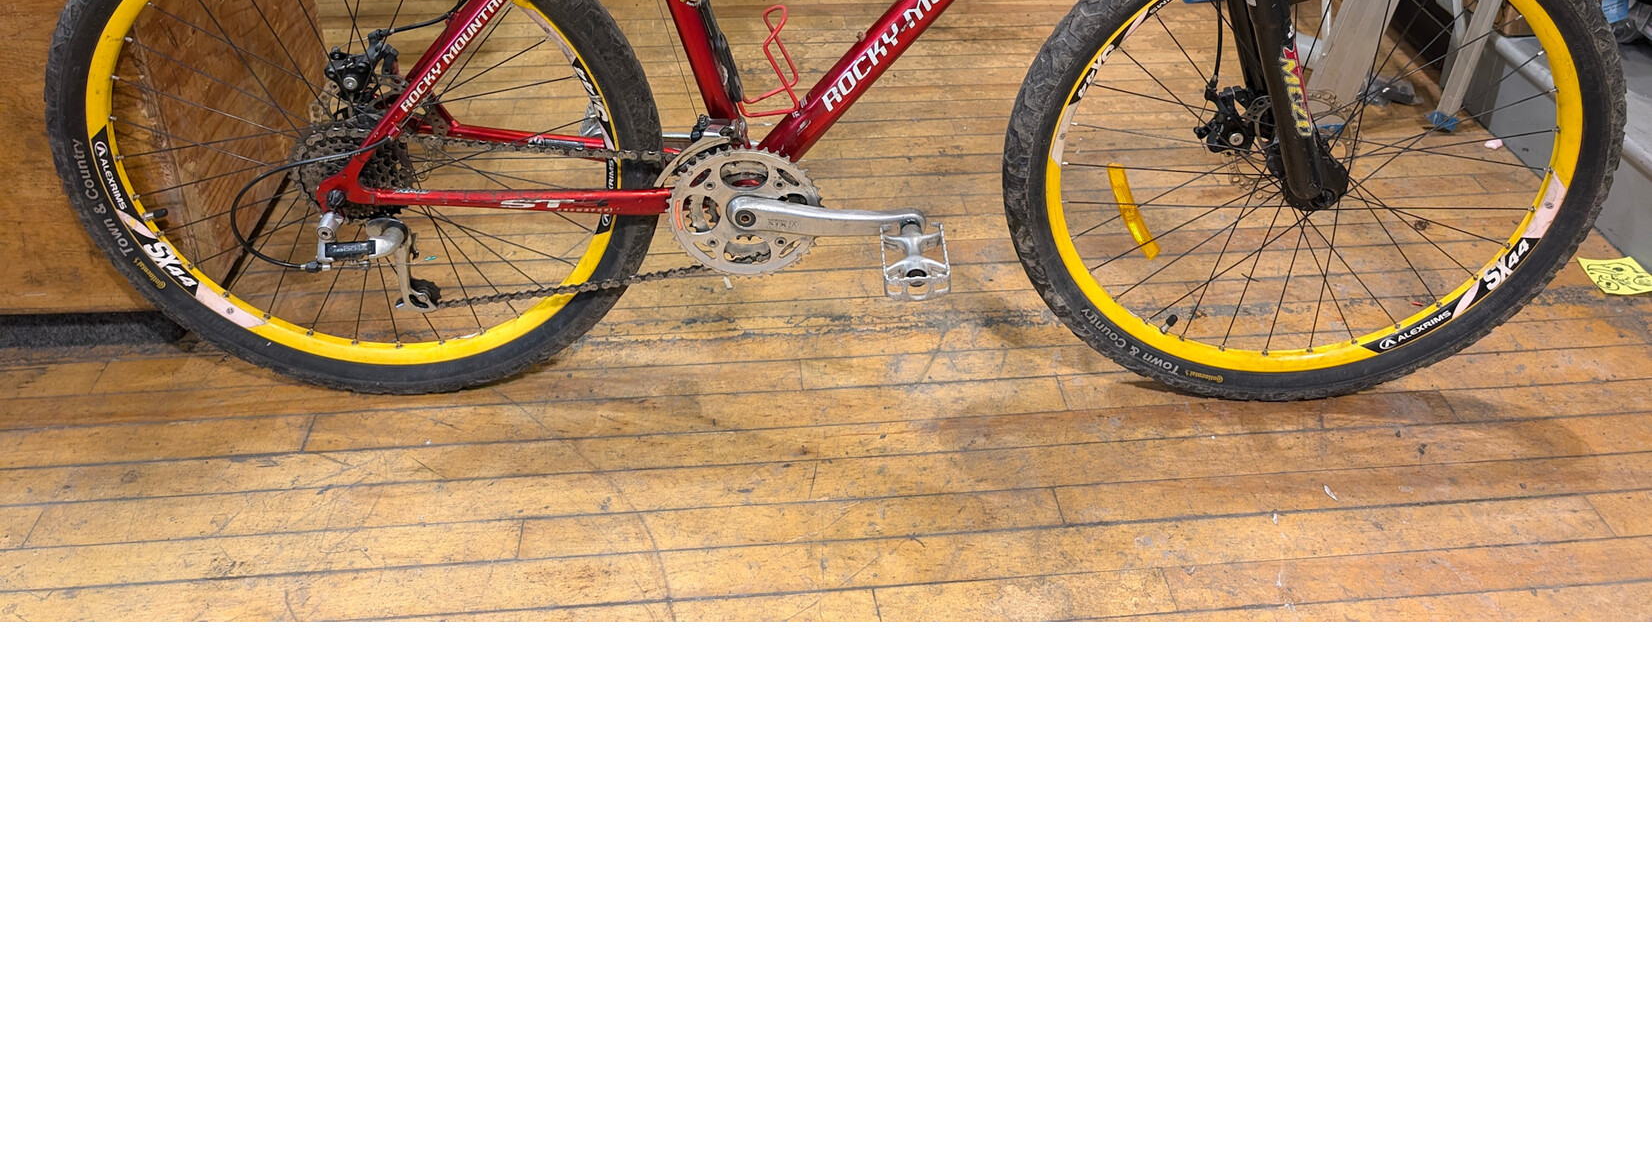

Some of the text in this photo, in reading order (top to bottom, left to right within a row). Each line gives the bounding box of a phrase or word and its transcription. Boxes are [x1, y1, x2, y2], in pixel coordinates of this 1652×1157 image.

[400, 62, 442, 113] ROCKY
[821, 22, 899, 113] ROCKY
[73, 139, 135, 257] Town & Country
[100, 158, 127, 211] ALEXRIMS
[143, 241, 198, 288] SX44
[1482, 238, 1530, 291] SX44
[1080, 307, 1180, 376] Town & Country
[1397, 309, 1452, 343] ALEXRIMS
